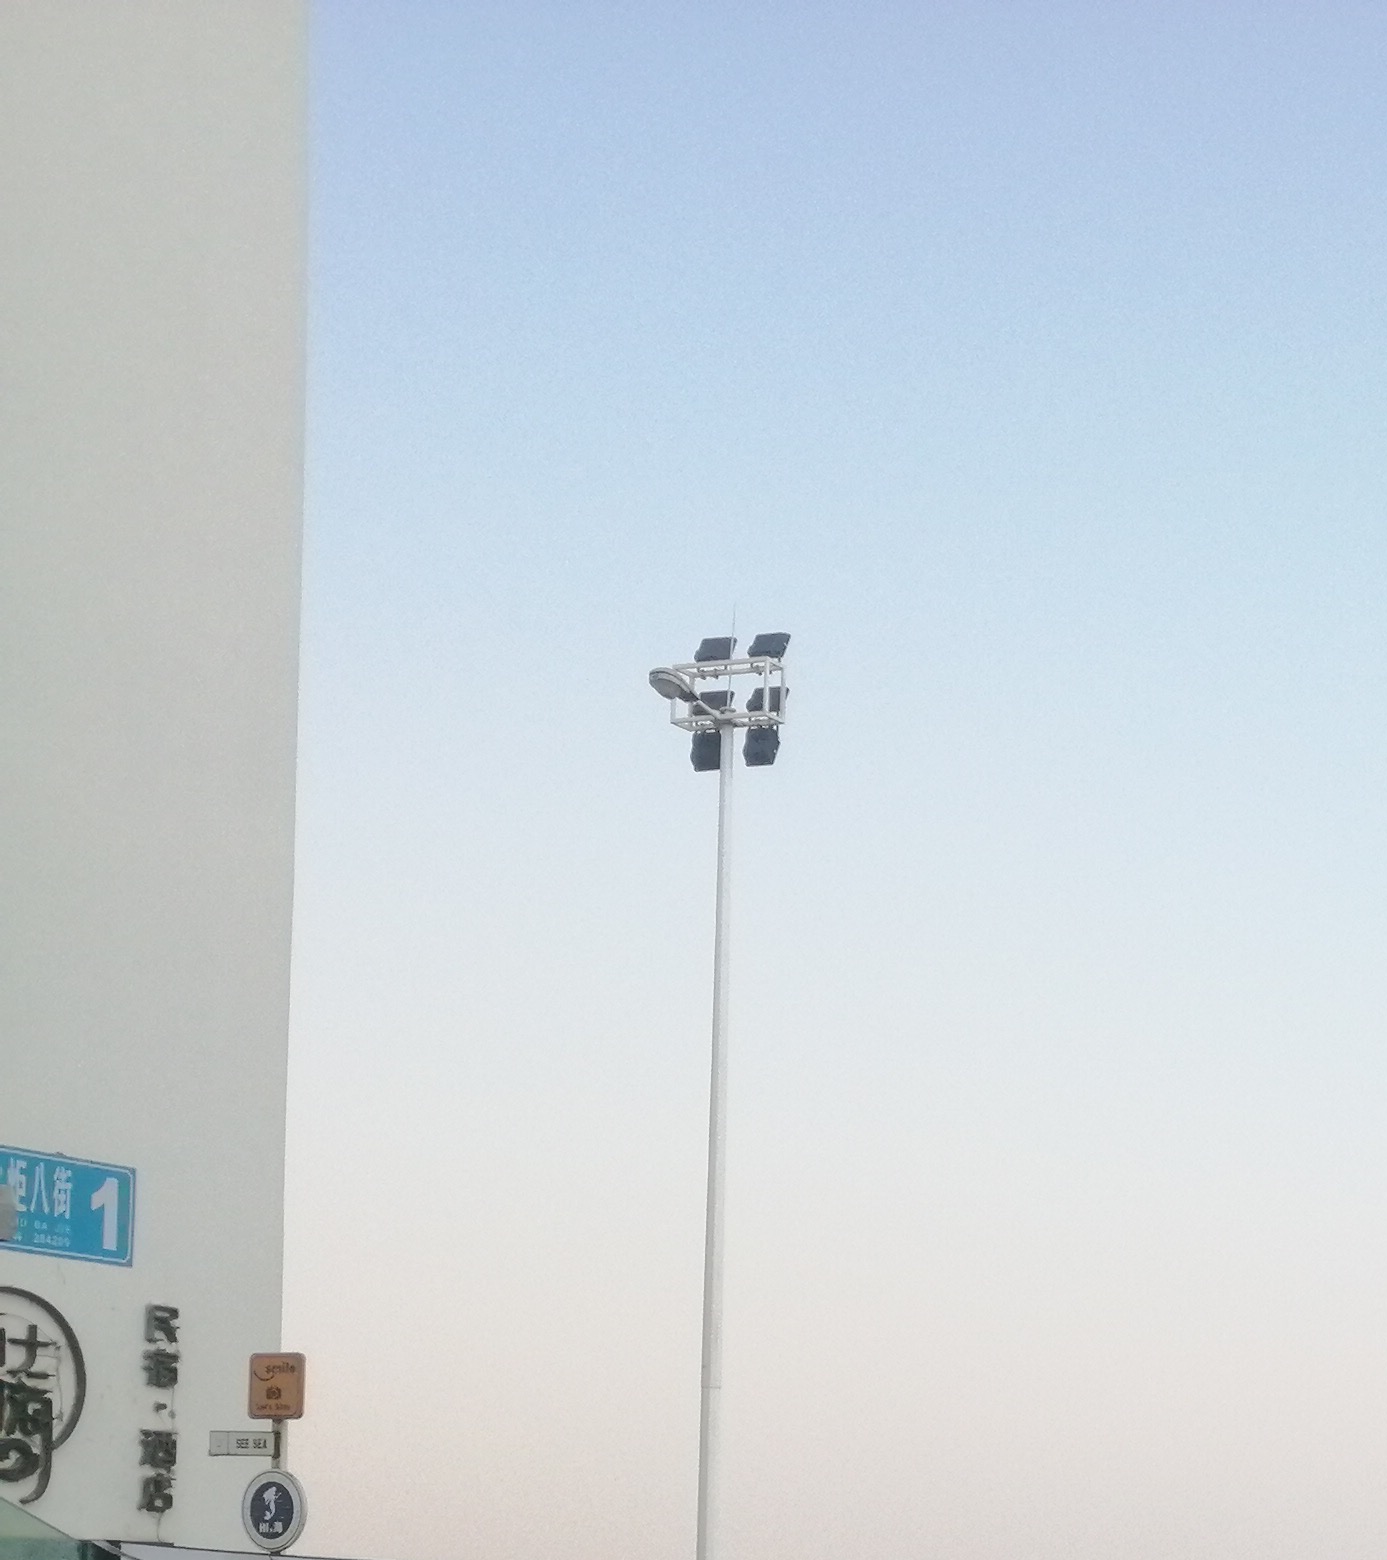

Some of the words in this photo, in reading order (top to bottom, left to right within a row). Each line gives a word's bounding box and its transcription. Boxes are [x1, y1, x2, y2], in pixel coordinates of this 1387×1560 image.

[0, 1157, 73, 1220] 炬八街
[90, 1176, 119, 1252] 1
[235, 1437, 250, 1450] SEE
[252, 1437, 268, 1450] SEA
